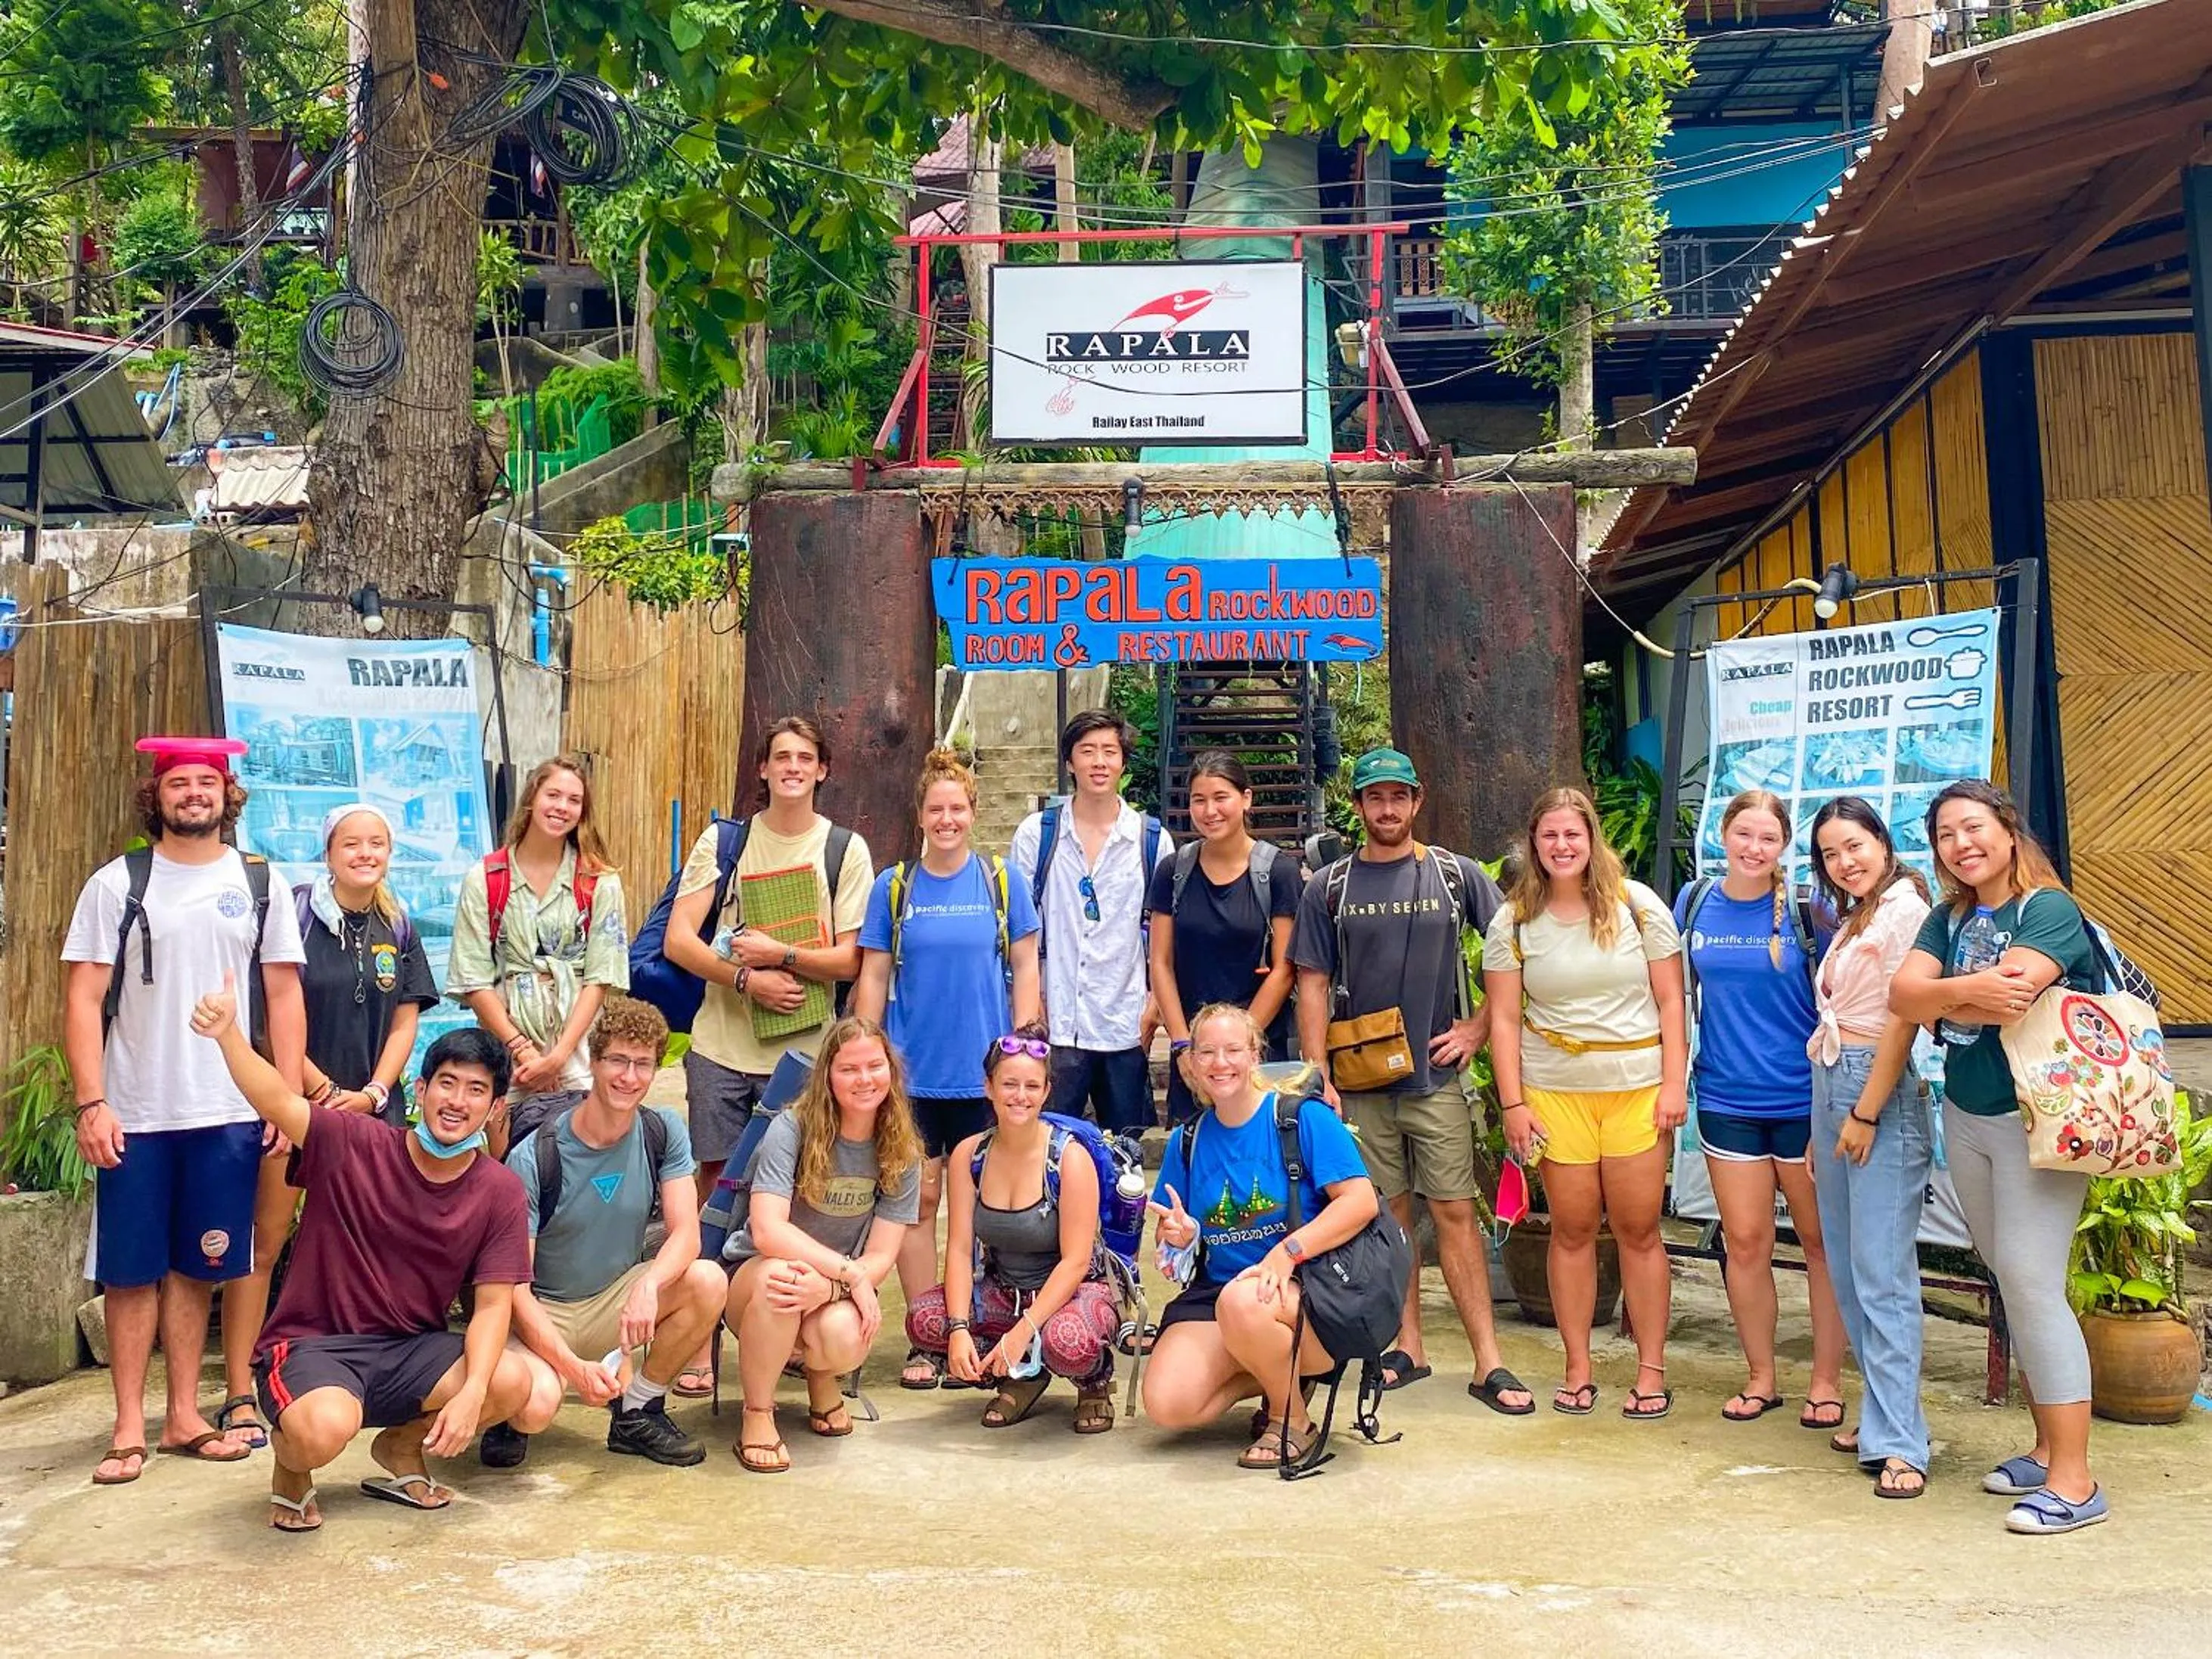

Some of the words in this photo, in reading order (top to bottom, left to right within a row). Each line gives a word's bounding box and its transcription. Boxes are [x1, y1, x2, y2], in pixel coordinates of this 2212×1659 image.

[1047, 333, 1249, 357] RAPALA
[1048, 363, 1094, 374] ROCK
[1111, 362, 1171, 374] WOOD
[1182, 361, 1247, 373] RESORT
[1092, 417, 1127, 429] Railay
[1130, 416, 1153, 427] East
[1155, 415, 1205, 427] Thailand
[966, 632, 1044, 663] ROOM
[1053, 623, 1090, 667] &
[1118, 630, 1311, 661] RESTAURANT
[1809, 631, 1895, 661] RAPALA
[234, 663, 305, 680] RAPALA
[347, 658, 470, 687] RAPALA
[1721, 662, 1793, 680] RAPALA
[1808, 657, 1944, 691] ROCKWOOD
[1749, 699, 1792, 715] Cheap
[1807, 694, 1894, 724] RESORT
[915, 904, 948, 914] pacific
[1707, 935, 1742, 944] pacific
[1745, 935, 1797, 945] discoery
